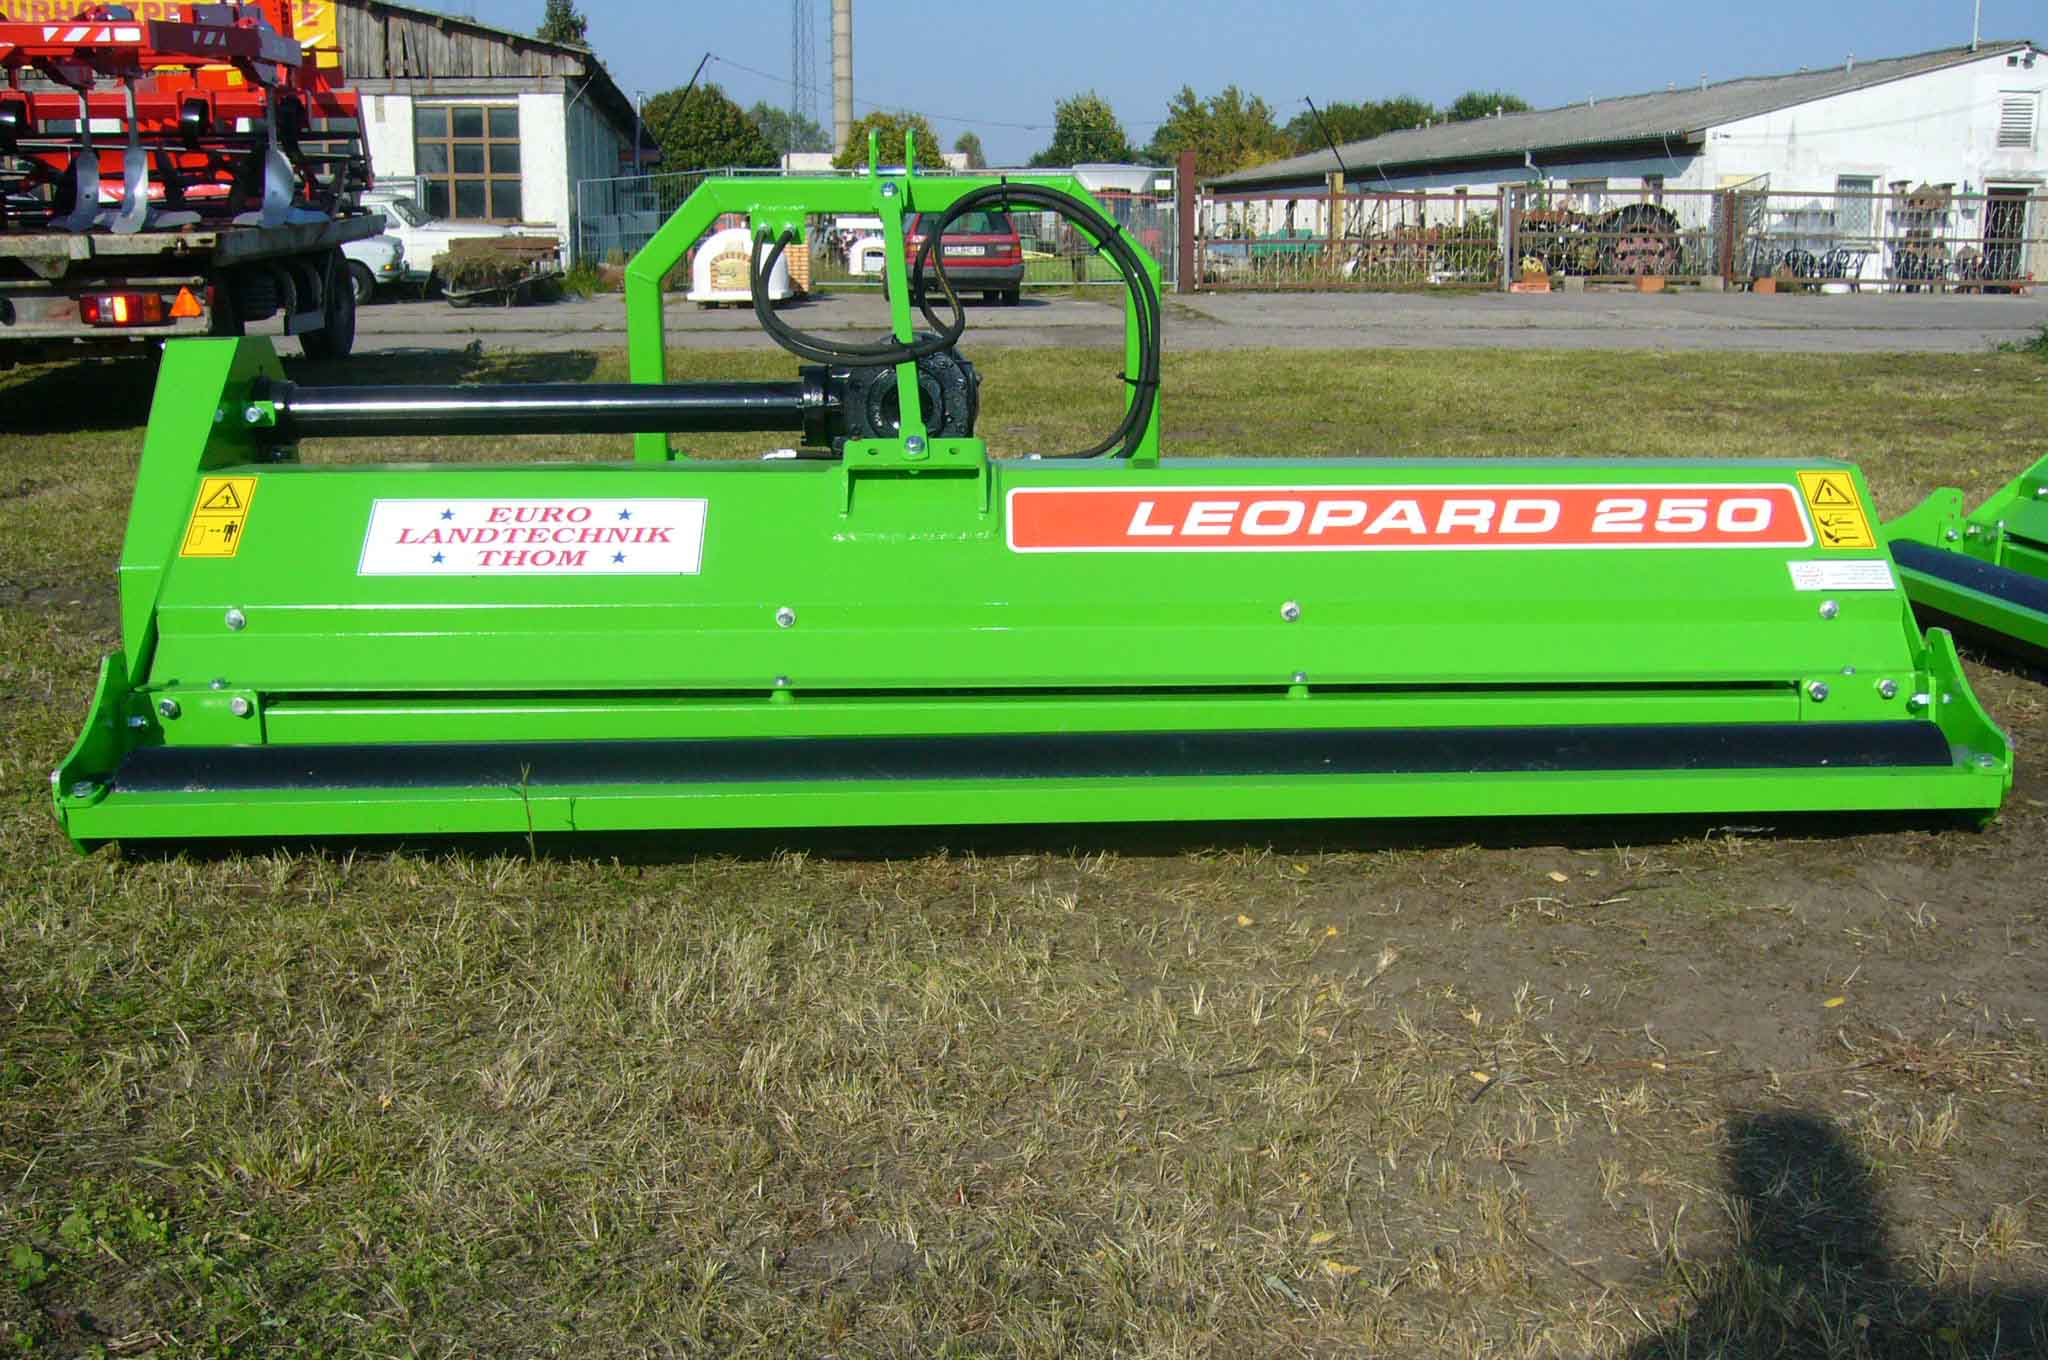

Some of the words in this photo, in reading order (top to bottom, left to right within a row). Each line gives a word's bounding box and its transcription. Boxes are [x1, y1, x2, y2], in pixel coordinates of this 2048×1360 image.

[486, 505, 593, 524] EURO
[1126, 498, 1562, 537] LEOPARD
[1590, 497, 1774, 535] 250
[395, 526, 676, 545] LANDTECHNIK
[478, 549, 590, 567] THOM
